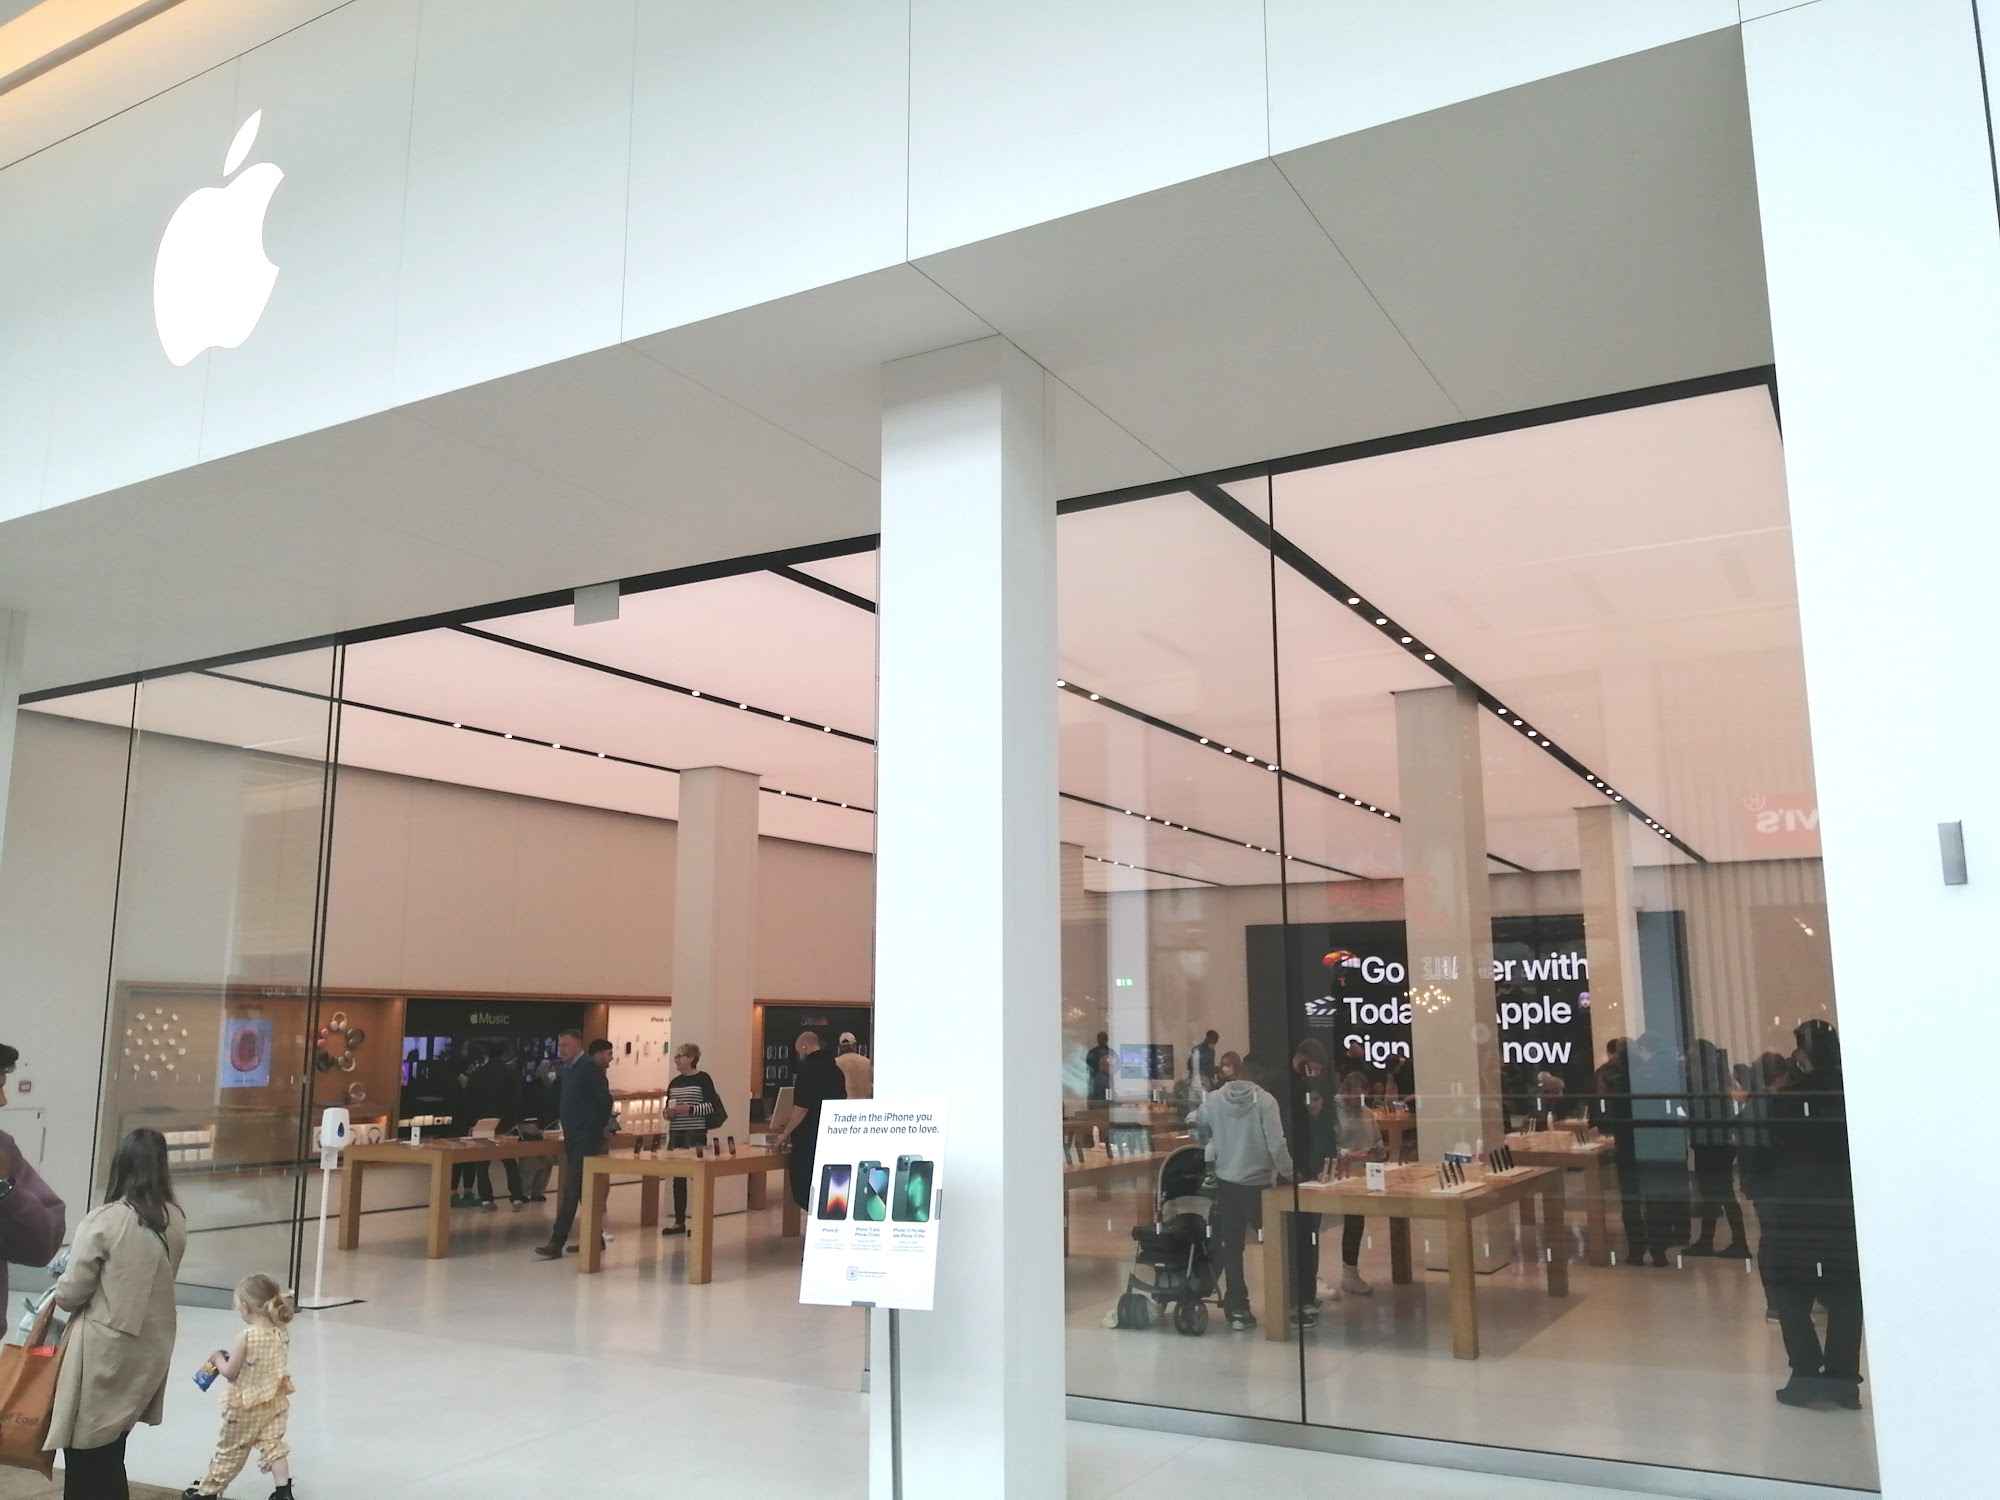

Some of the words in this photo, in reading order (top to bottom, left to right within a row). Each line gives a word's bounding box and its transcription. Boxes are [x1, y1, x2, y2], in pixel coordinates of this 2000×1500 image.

[1361, 956, 1405, 984] Go
[1521, 952, 1589, 982] with
[479, 1012, 510, 1025] Music
[1343, 997, 1412, 1026] Toda
[1495, 995, 1572, 1031] pple
[834, 1113, 857, 1122] Trade
[859, 1113, 867, 1121] in
[868, 1113, 882, 1122] the
[884, 1112, 914, 1122] iPhone
[916, 1113, 933, 1123] you
[827, 1125, 848, 1134] have
[849, 1124, 861, 1134] for
[863, 1126, 868, 1134] a
[870, 1126, 888, 1134] new
[890, 1125, 906, 1134] one
[908, 1124, 918, 1134] to
[919, 1124, 940, 1134] love.
